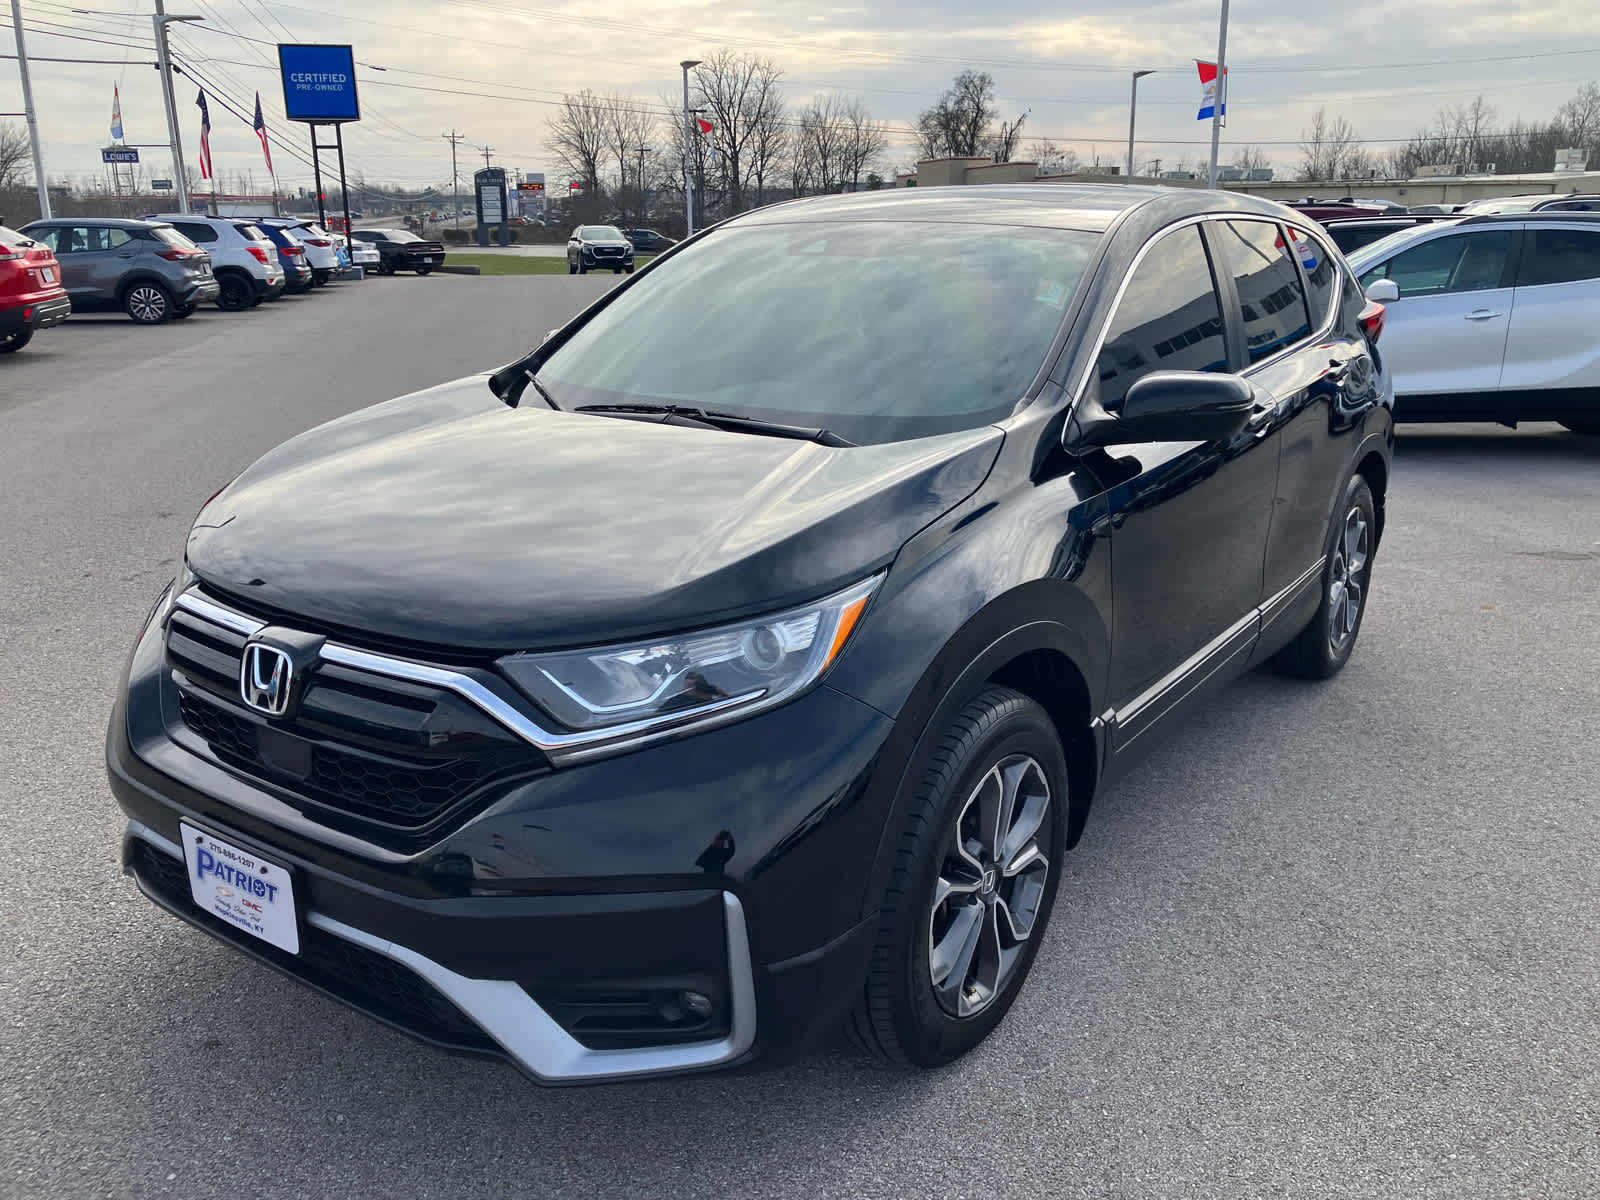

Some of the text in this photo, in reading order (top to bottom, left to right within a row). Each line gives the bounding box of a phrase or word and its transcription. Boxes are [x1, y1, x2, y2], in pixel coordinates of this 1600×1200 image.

[290, 73, 346, 83] CERTIFIED
[296, 83, 344, 91] PRE-OWNED
[103, 152, 137, 161] LOWE'S
[197, 846, 278, 902] PATRIOT
